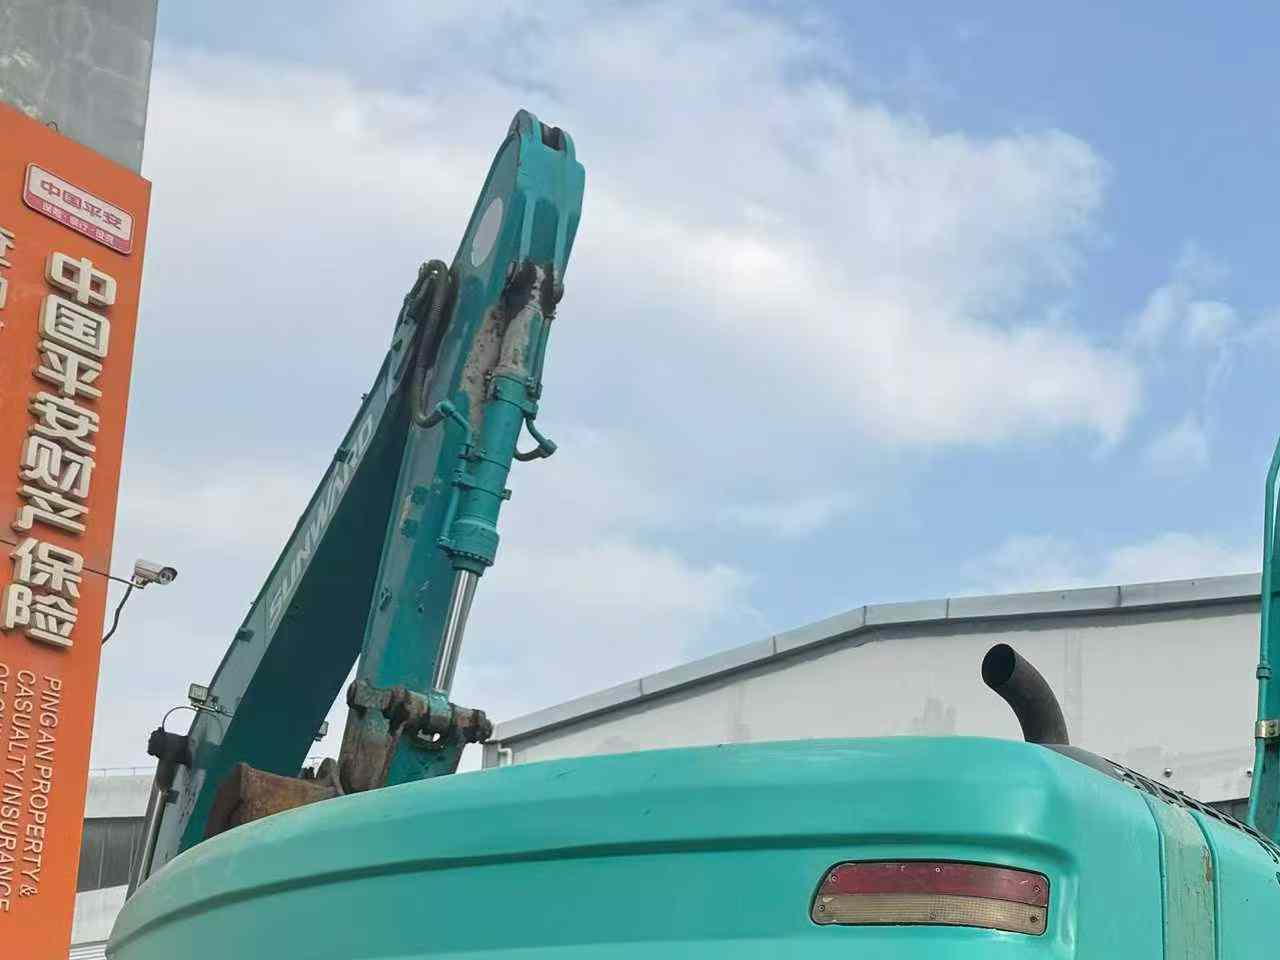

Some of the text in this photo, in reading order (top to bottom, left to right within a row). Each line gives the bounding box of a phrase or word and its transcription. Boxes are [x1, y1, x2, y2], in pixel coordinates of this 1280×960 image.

[40, 180, 122, 231] 中国平安
[1, 250, 118, 649] 中国平安财产保险
[269, 413, 373, 630] SUNWARD
[5, 670, 36, 782] CASUALTY
[21, 763, 52, 882] PROPERTY
